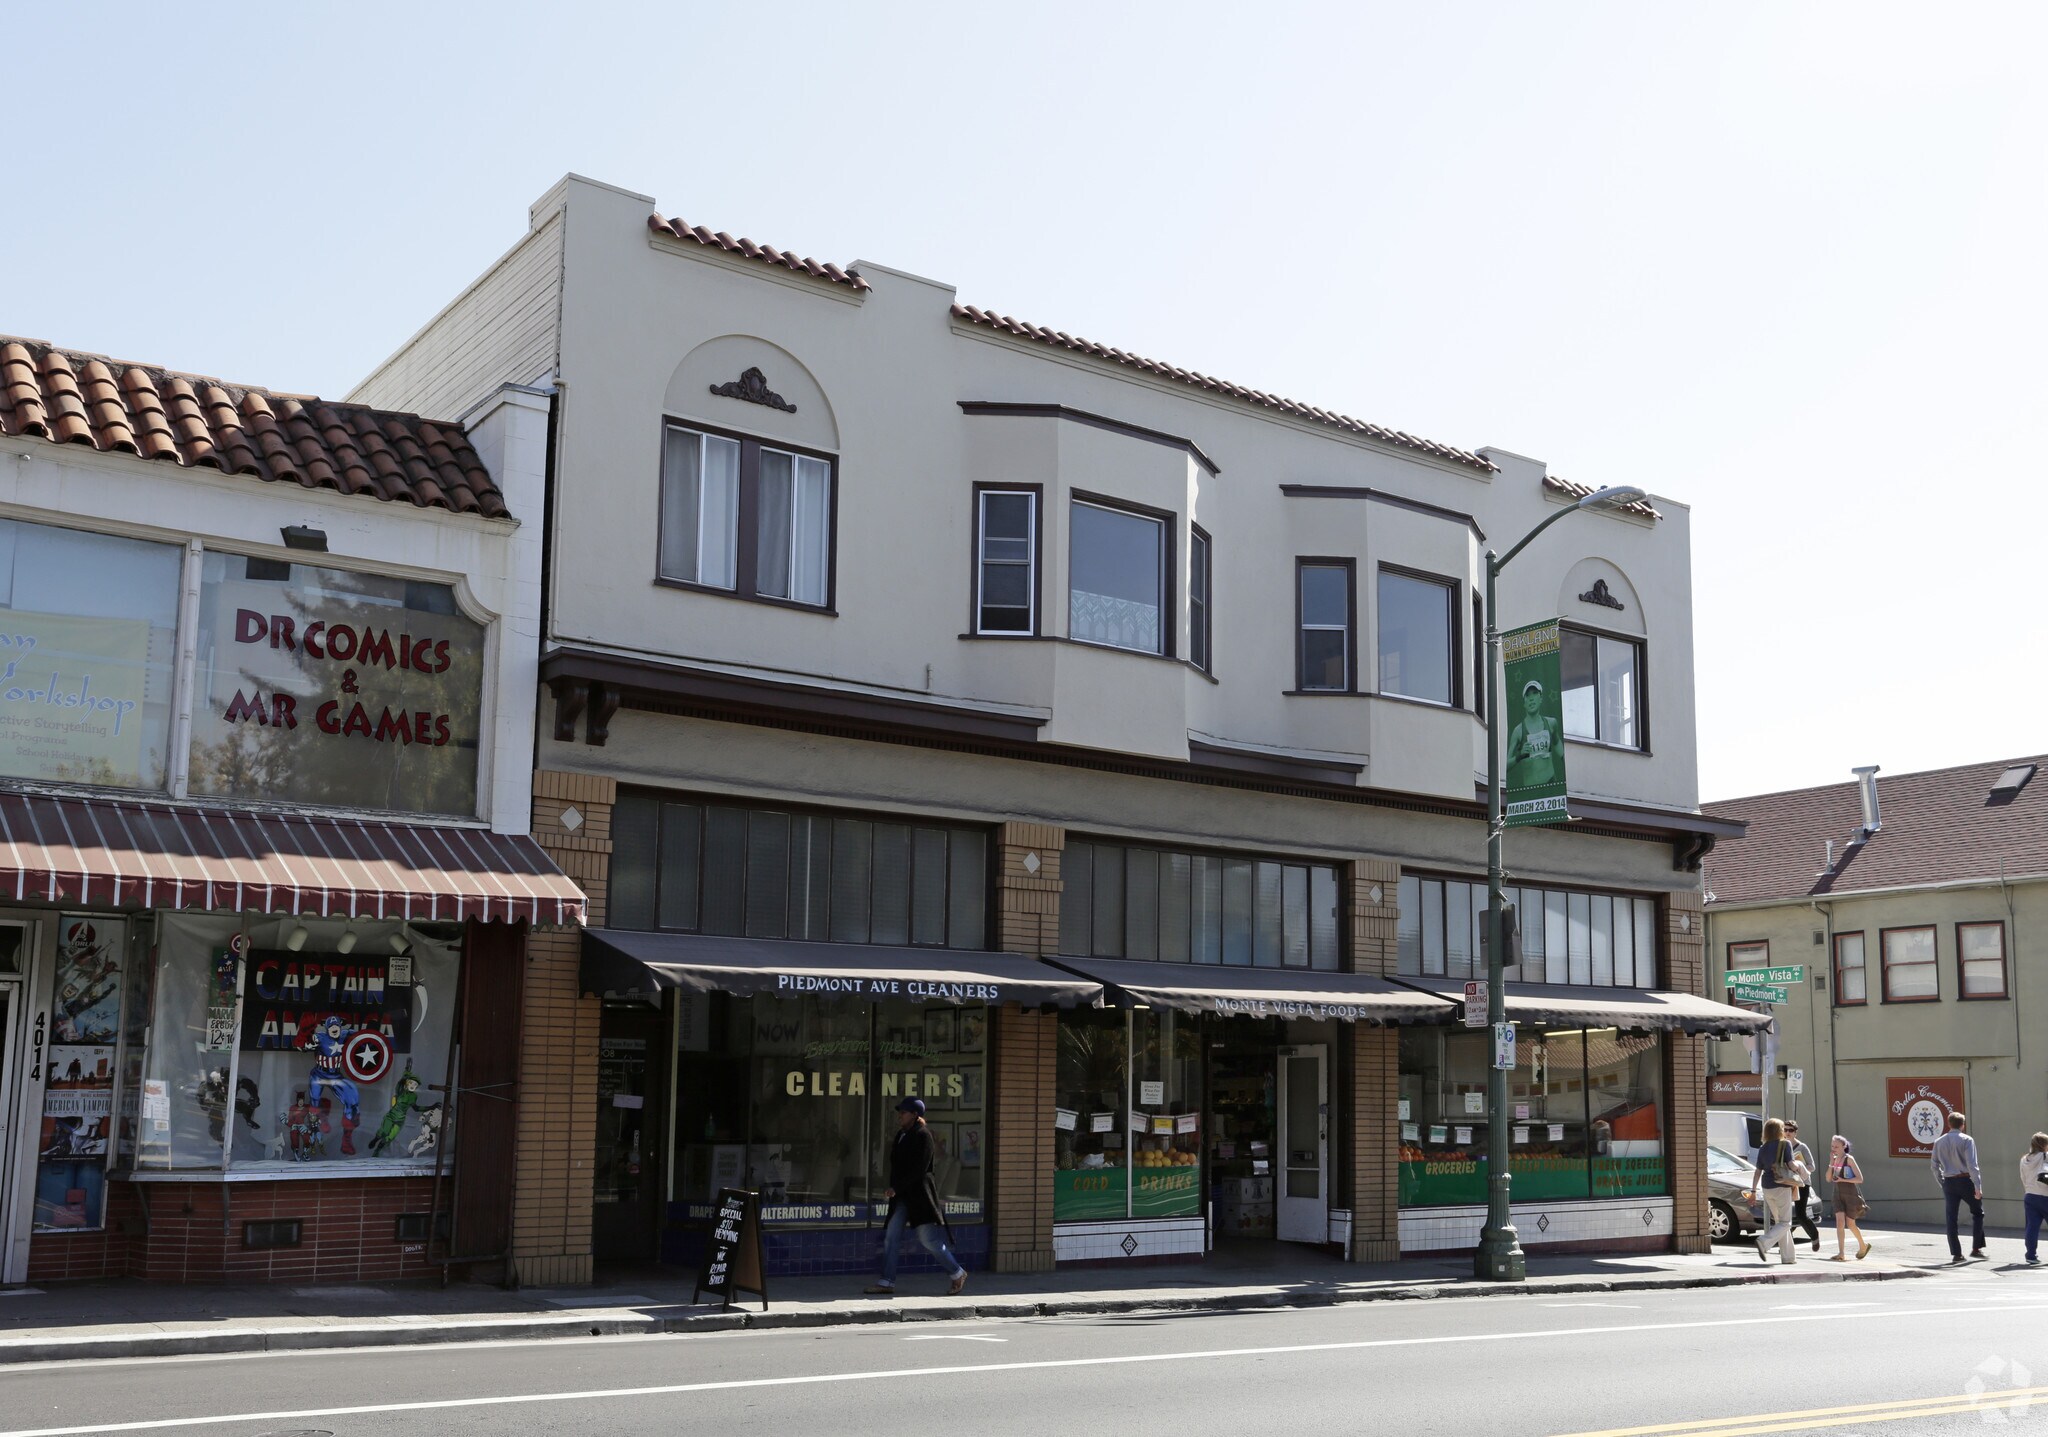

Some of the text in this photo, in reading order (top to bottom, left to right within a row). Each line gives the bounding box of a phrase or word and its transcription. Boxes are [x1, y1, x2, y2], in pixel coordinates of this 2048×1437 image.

[235, 608, 452, 675] DR COMICS
[1503, 627, 1559, 651] OAKLAND
[1505, 640, 1560, 660] RUNNING FESTIVAL
[341, 669, 360, 695] &
[223, 688, 452, 747] MR GAMES
[34, 717, 108, 738] Storytelling
[15, 746, 49, 759] School
[1508, 803, 1534, 815] MARCH
[256, 960, 385, 1004] CAPTAIN
[1738, 973, 1765, 983] Monte
[1768, 969, 1792, 981] Vista
[778, 974, 999, 999] PIEDMONT AVE CLEANERS
[1466, 983, 1476, 994] NO
[1744, 986, 1777, 1000] Piedmont
[1214, 997, 1367, 1018] MONTE VISTA FOODS
[1466, 995, 1487, 1004] PARKING
[757, 1020, 800, 1043] NOW
[31, 1011, 45, 1081] 4014
[786, 1070, 963, 1098] CLEANERS
[1711, 1081, 1732, 1092] Bella
[1892, 1090, 1917, 1116] Bella
[1425, 1161, 1477, 1175] GROCERIES
[1509, 1158, 1539, 1172] FRESH
[1593, 1159, 1622, 1173] FRESH
[1140, 1175, 1192, 1192] DRINKS
[1596, 1174, 1663, 1188] ORANGE JUICE
[720, 1208, 742, 1221] SPECIAL
[761, 1206, 823, 1221] ALTERATIONS
[830, 1205, 857, 1219] RUGS
[945, 1202, 981, 1215] LEATHER
[714, 1228, 738, 1243] HEMMING
